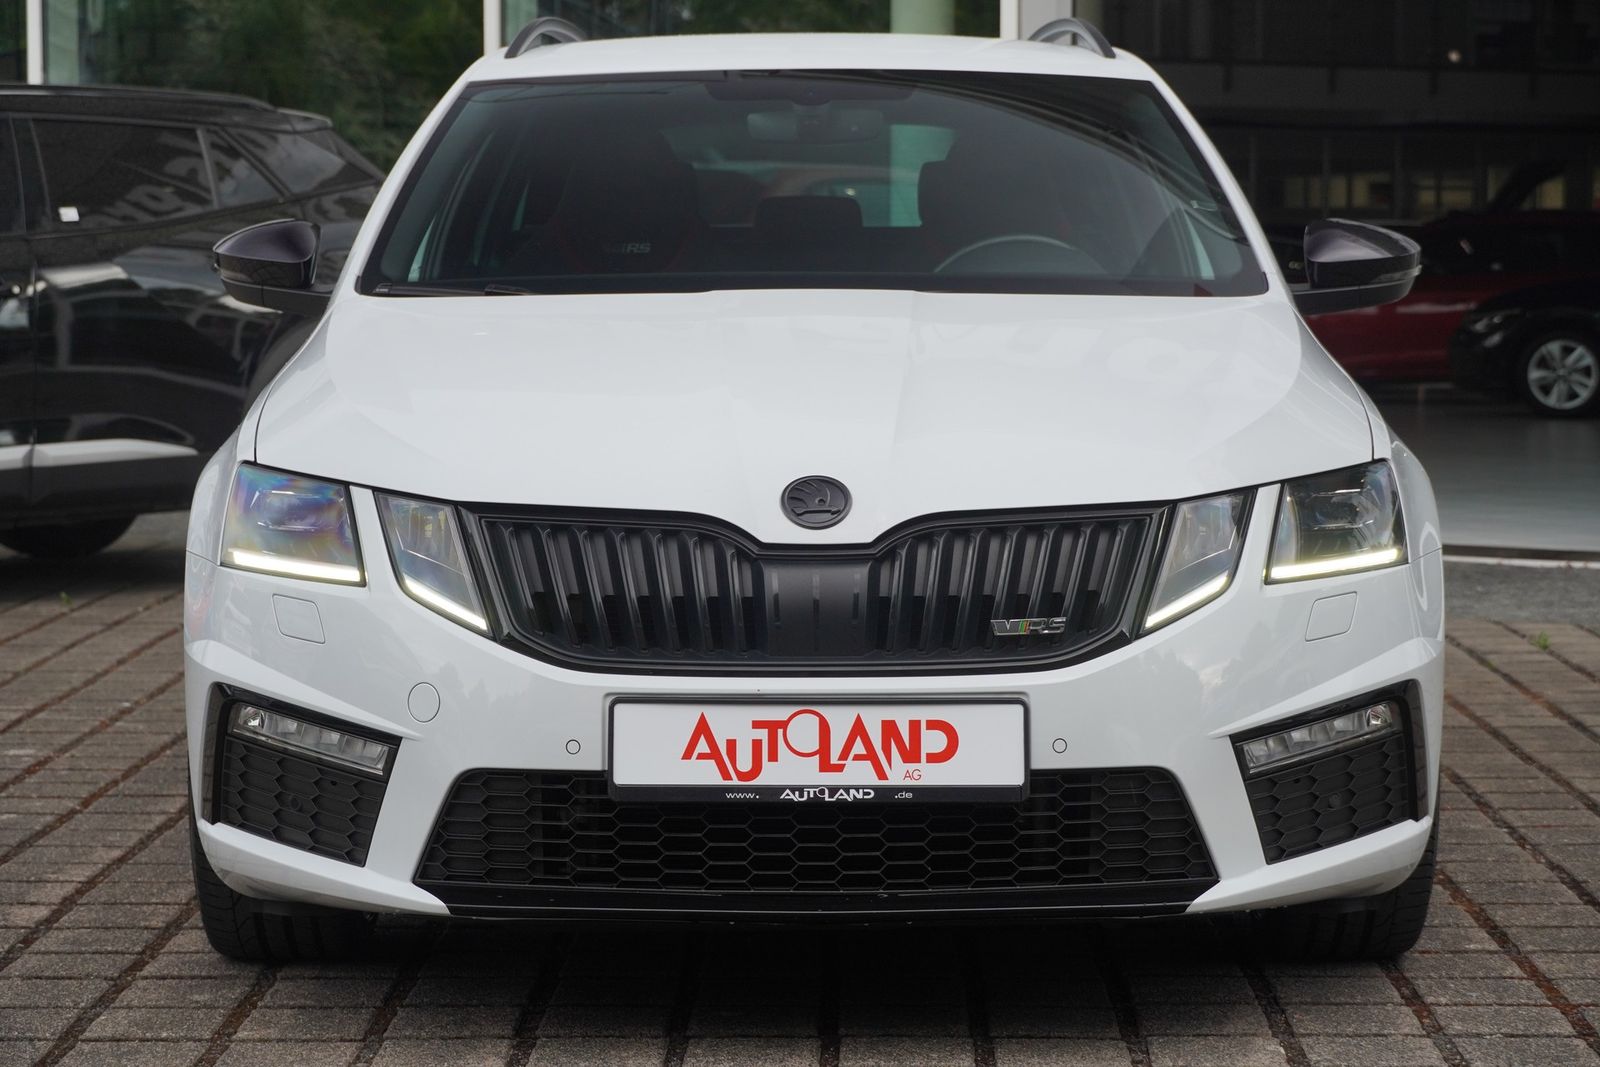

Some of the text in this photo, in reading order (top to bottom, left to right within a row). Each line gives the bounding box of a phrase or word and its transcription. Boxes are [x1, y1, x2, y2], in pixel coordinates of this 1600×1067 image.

[681, 708, 959, 781] AUTOLAND
[903, 769, 922, 781] AG
[780, 786, 875, 801] AUTOLAND
[895, 791, 913, 799] .de
